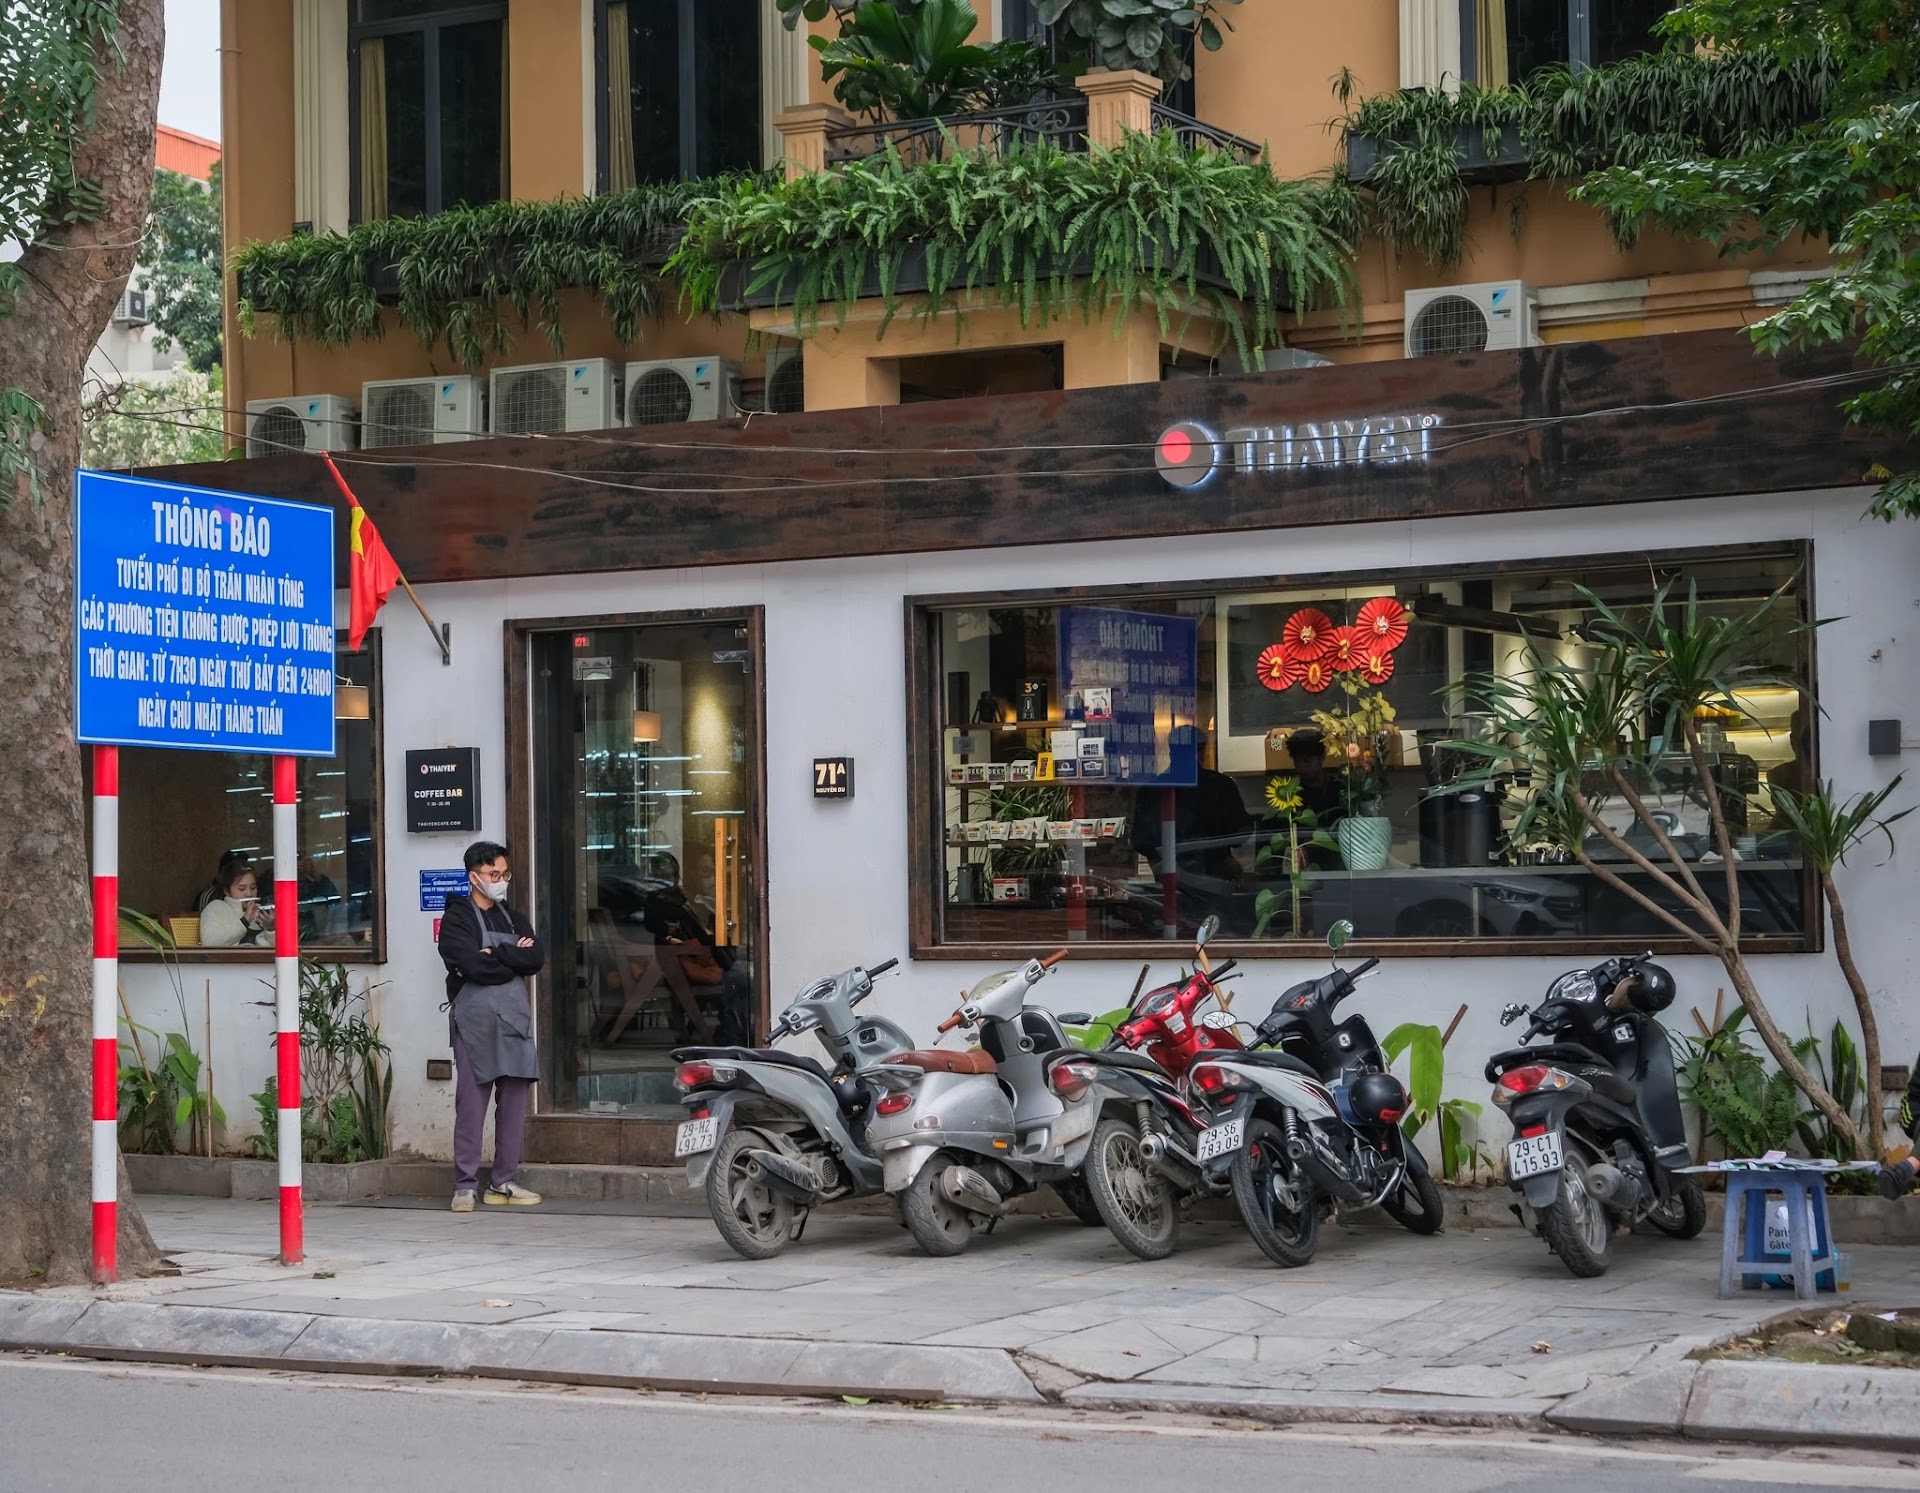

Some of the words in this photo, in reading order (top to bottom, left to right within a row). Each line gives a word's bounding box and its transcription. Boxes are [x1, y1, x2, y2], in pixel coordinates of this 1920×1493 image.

[1226, 415, 1428, 473] THAIYEN
[152, 496, 222, 551] THÔNG
[230, 506, 270, 558] BÁO
[116, 553, 152, 591] TUYẾN
[157, 557, 179, 594] PHỐ
[182, 566, 193, 596] ĐI
[197, 562, 211, 604] BỘ
[214, 563, 242, 602] TRẦN
[246, 570, 275, 605] NHÂN
[278, 573, 304, 609] TÔNG
[81, 594, 105, 631] CÁC
[108, 601, 153, 636] PHƯƠNG
[155, 602, 179, 644] TIỆN
[182, 606, 218, 642] KHÔNG
[221, 613, 249, 651] ĐƯỢC
[252, 613, 278, 648] PHÉP
[281, 619, 299, 650] LƯU
[302, 618, 332, 653] THÔNG
[89, 642, 115, 679] THỜI
[118, 650, 149, 682] GIAN:
[152, 647, 167, 683] TỪ
[170, 654, 197, 685] 7H30
[200, 653, 227, 688] NGÀY
[230, 655, 252, 690] THỨ
[255, 653, 274, 692] BẢY
[277, 658, 298, 694] ĐẾN
[300, 667, 332, 697] 24H00
[138, 692, 166, 728] NGÀY
[170, 690, 191, 730] CHỦ
[195, 697, 222, 738] NHẬT
[225, 698, 254, 734] HÀNG
[257, 699, 283, 736] TUẦN
[429, 764, 456, 773] THAIYEN
[815, 763, 846, 785] 71A
[414, 790, 445, 798] COFFEE
[446, 788, 462, 797] BAR
[682, 1120, 710, 1138] 29-H2
[1205, 1122, 1236, 1144] 29-S6
[678, 1133, 712, 1153] 492.73
[1201, 1134, 1239, 1160] 783.09
[1515, 1135, 1551, 1158] 29-C1
[1515, 1151, 1559, 1175] 415.93
